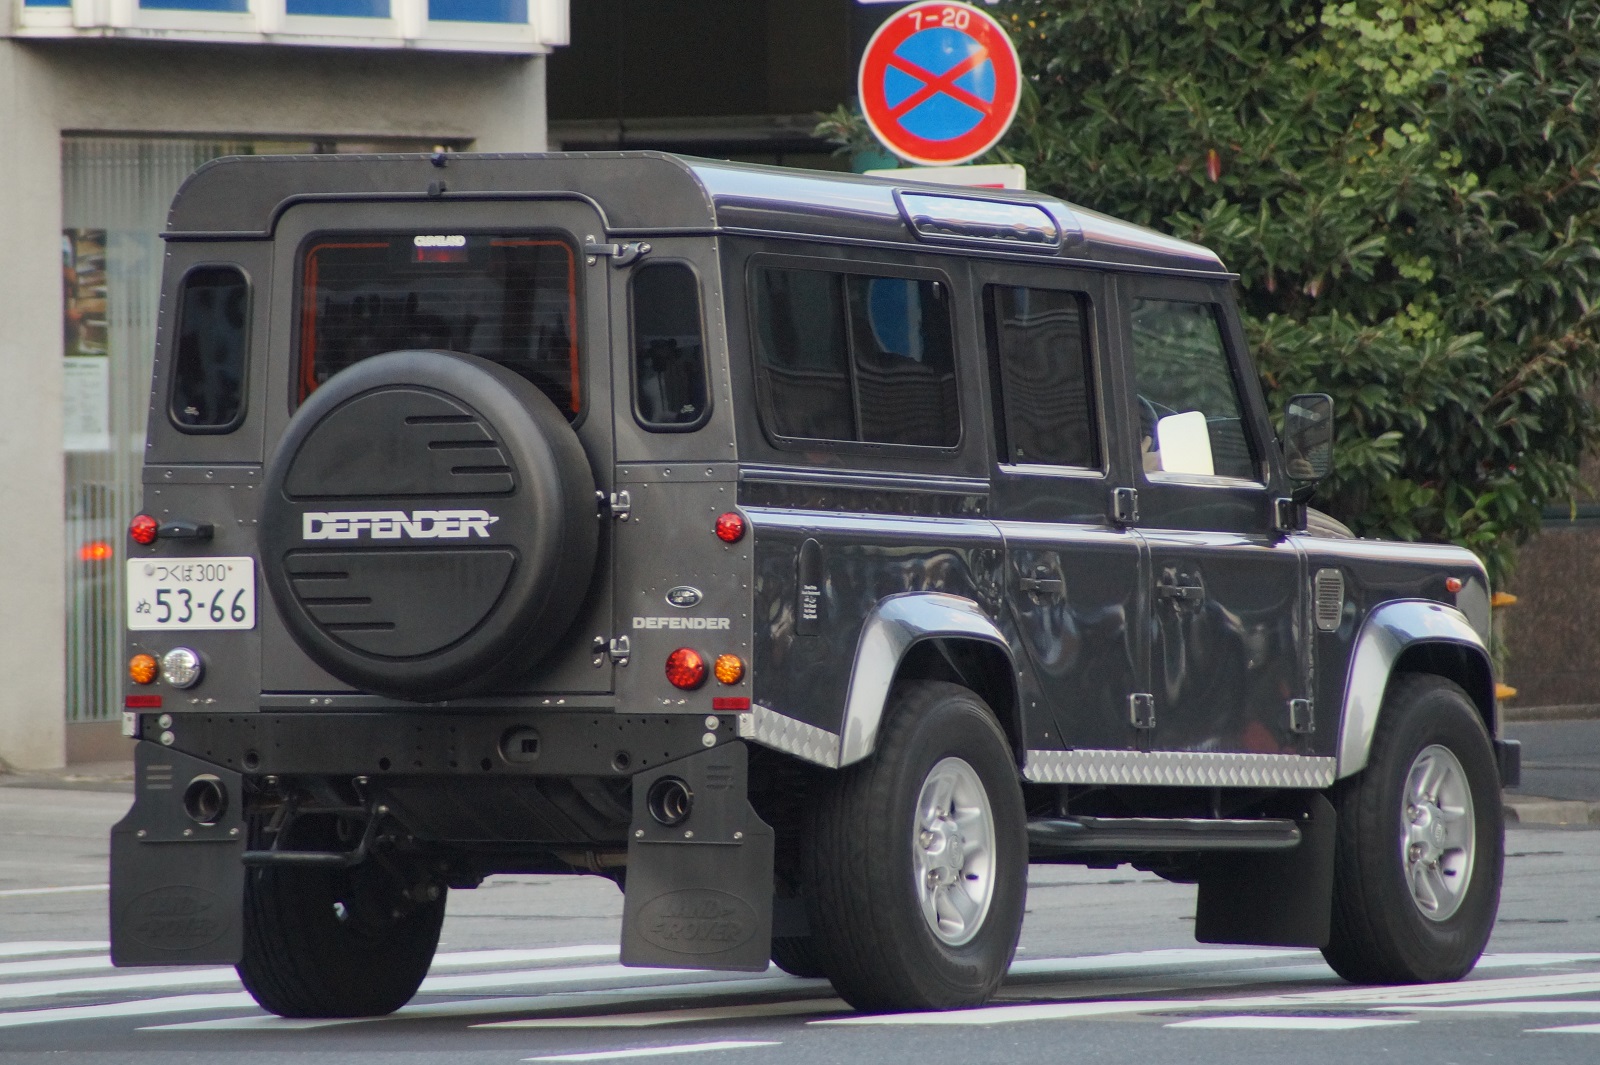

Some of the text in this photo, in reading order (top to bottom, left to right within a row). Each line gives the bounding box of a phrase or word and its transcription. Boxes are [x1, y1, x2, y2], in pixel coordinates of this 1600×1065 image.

[908, 7, 970, 31] 7-20
[303, 509, 499, 540] DEFENDER
[156, 588, 246, 623] 53-66
[632, 616, 731, 630] DEFENDER
